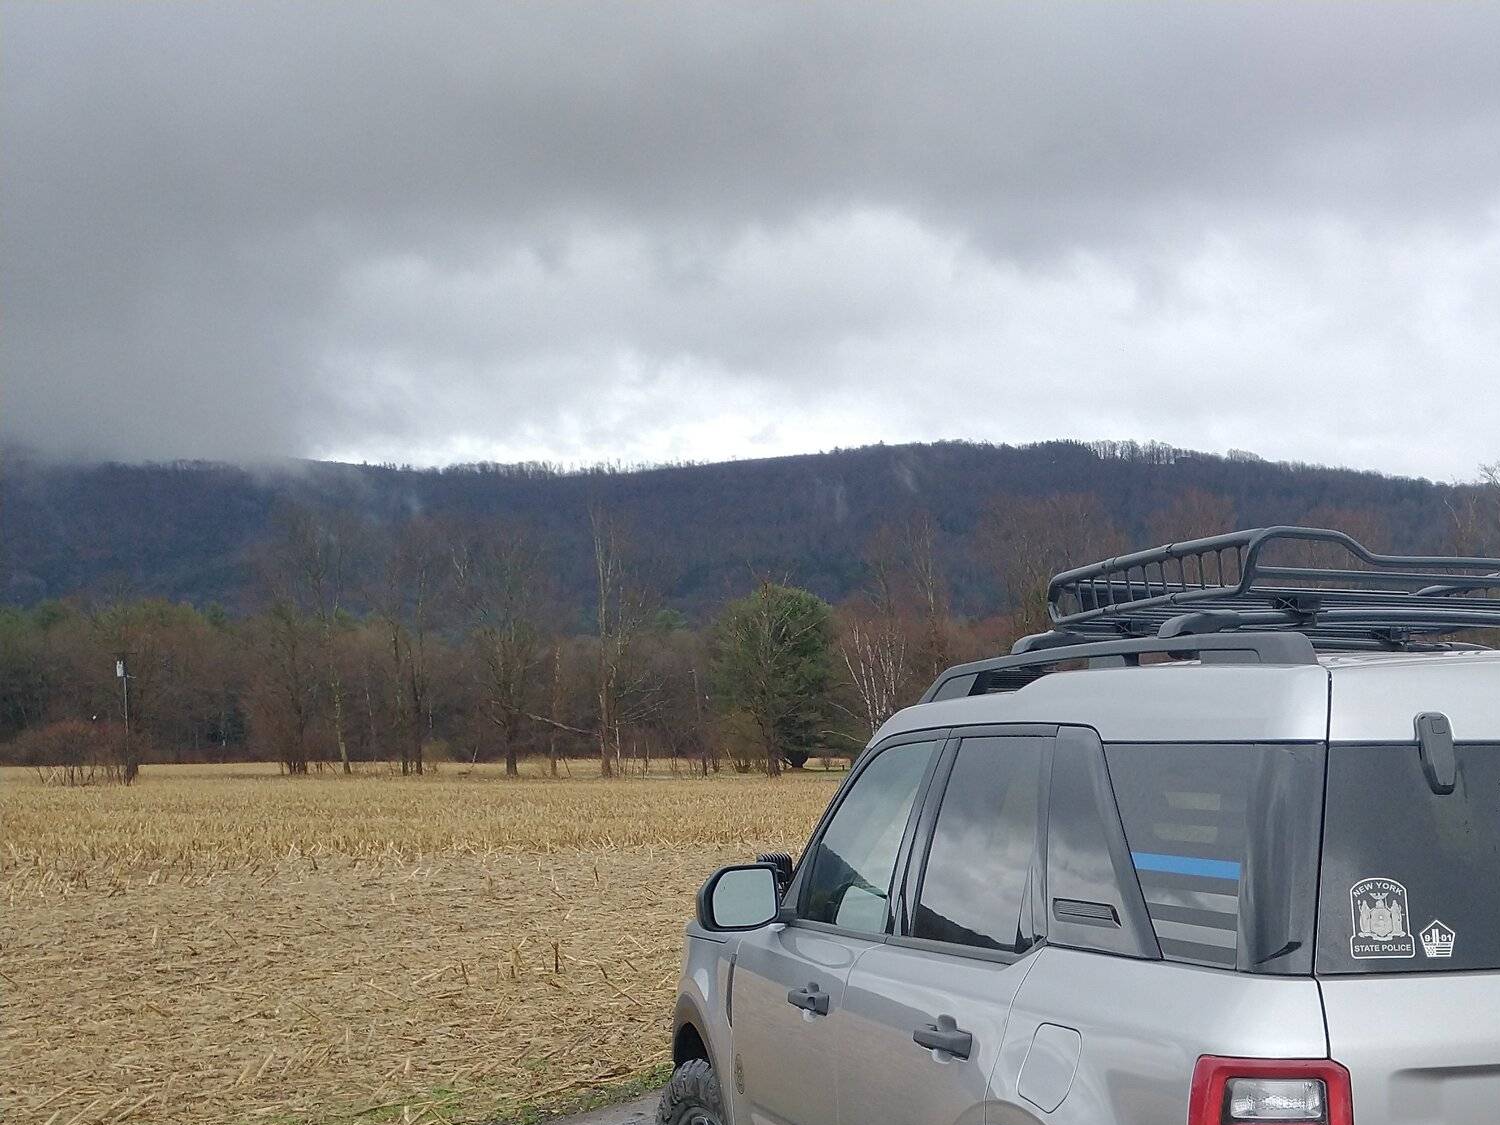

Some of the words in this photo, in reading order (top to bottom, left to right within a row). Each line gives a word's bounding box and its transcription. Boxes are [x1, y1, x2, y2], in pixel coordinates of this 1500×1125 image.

[1353, 883, 1373, 897] NEW
[1376, 881, 1403, 896] YORK
[1354, 944, 1380, 953] STATE
[1382, 944, 1412, 952] POLICE
